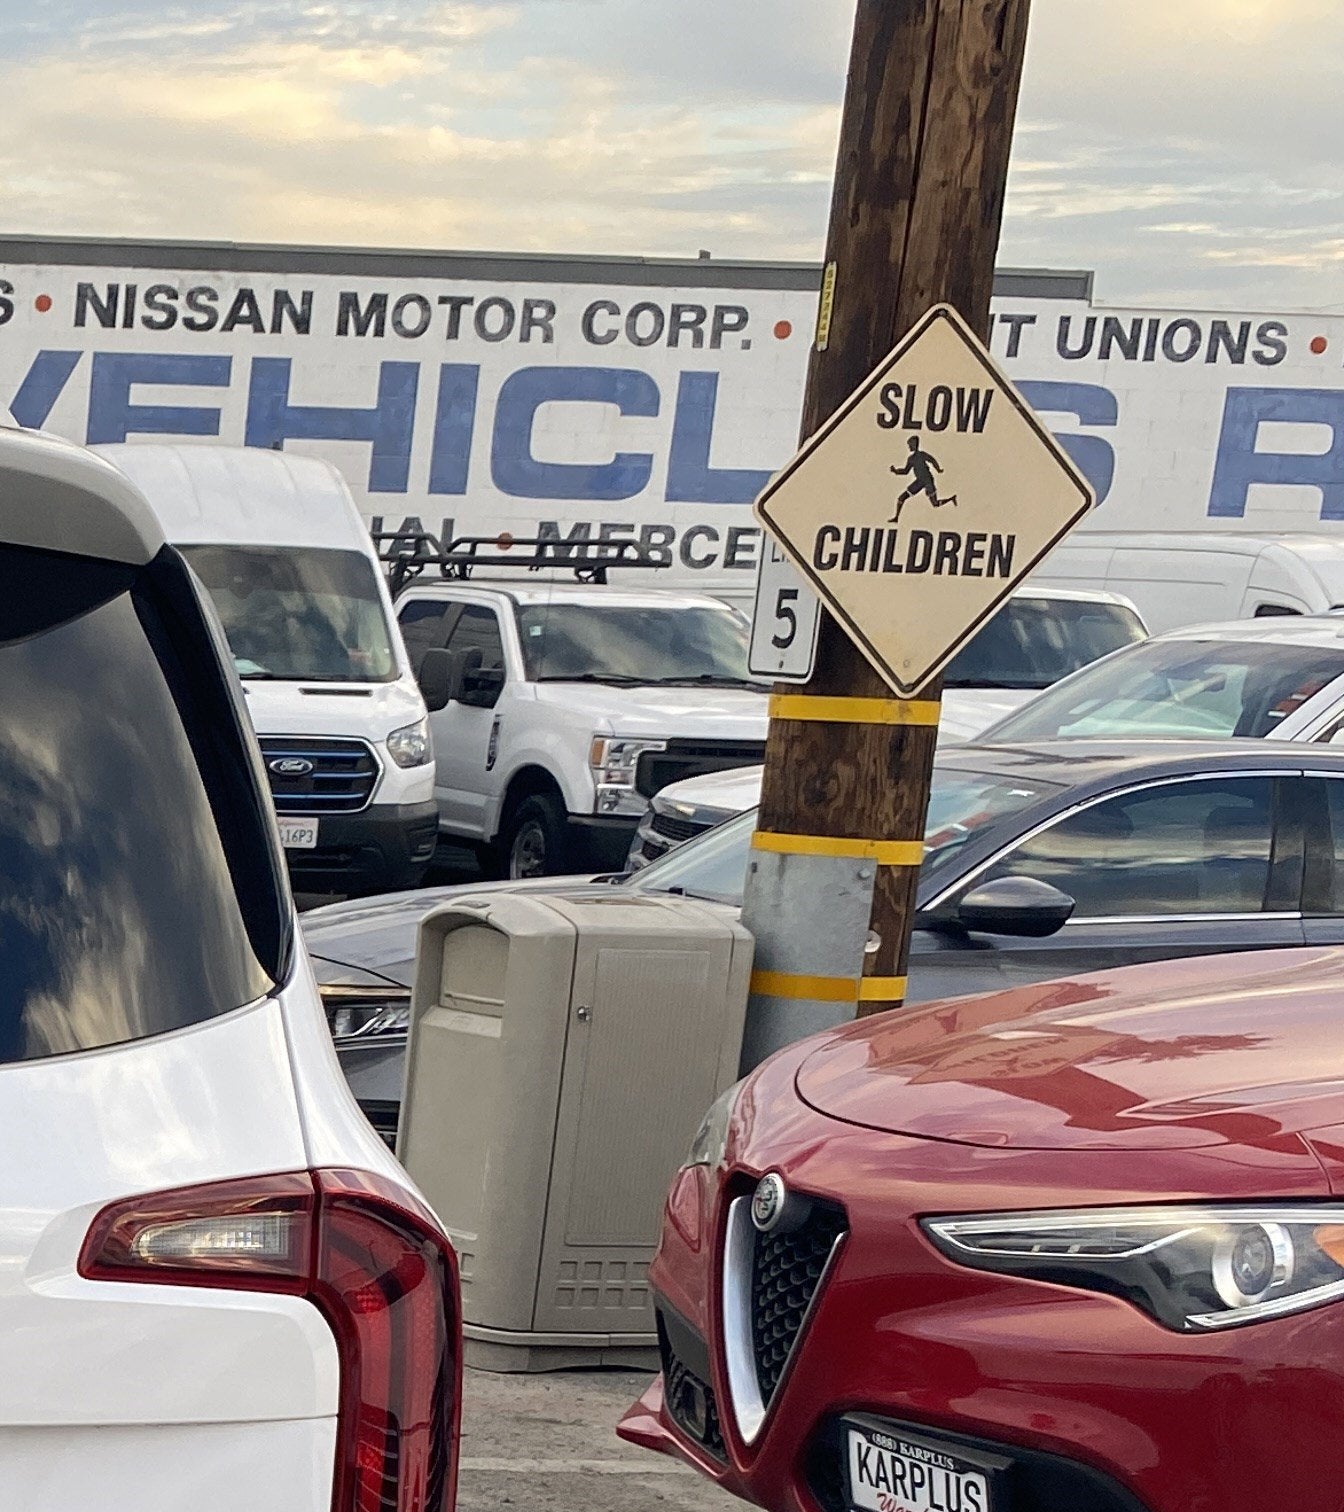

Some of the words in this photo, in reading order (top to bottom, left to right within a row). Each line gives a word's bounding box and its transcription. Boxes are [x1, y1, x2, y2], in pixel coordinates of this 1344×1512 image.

[72, 281, 315, 336] NISSAN
[337, 291, 557, 344] MOTOR
[582, 299, 752, 351] CORP.
[1056, 315, 1289, 367] UNIONS
[876, 381, 994, 434] SLOW
[537, 520, 761, 570] MERCE
[813, 524, 1017, 580] CHILDREN
[771, 588, 800, 650] 5
[899, 1441, 955, 1470] KARPLUS
